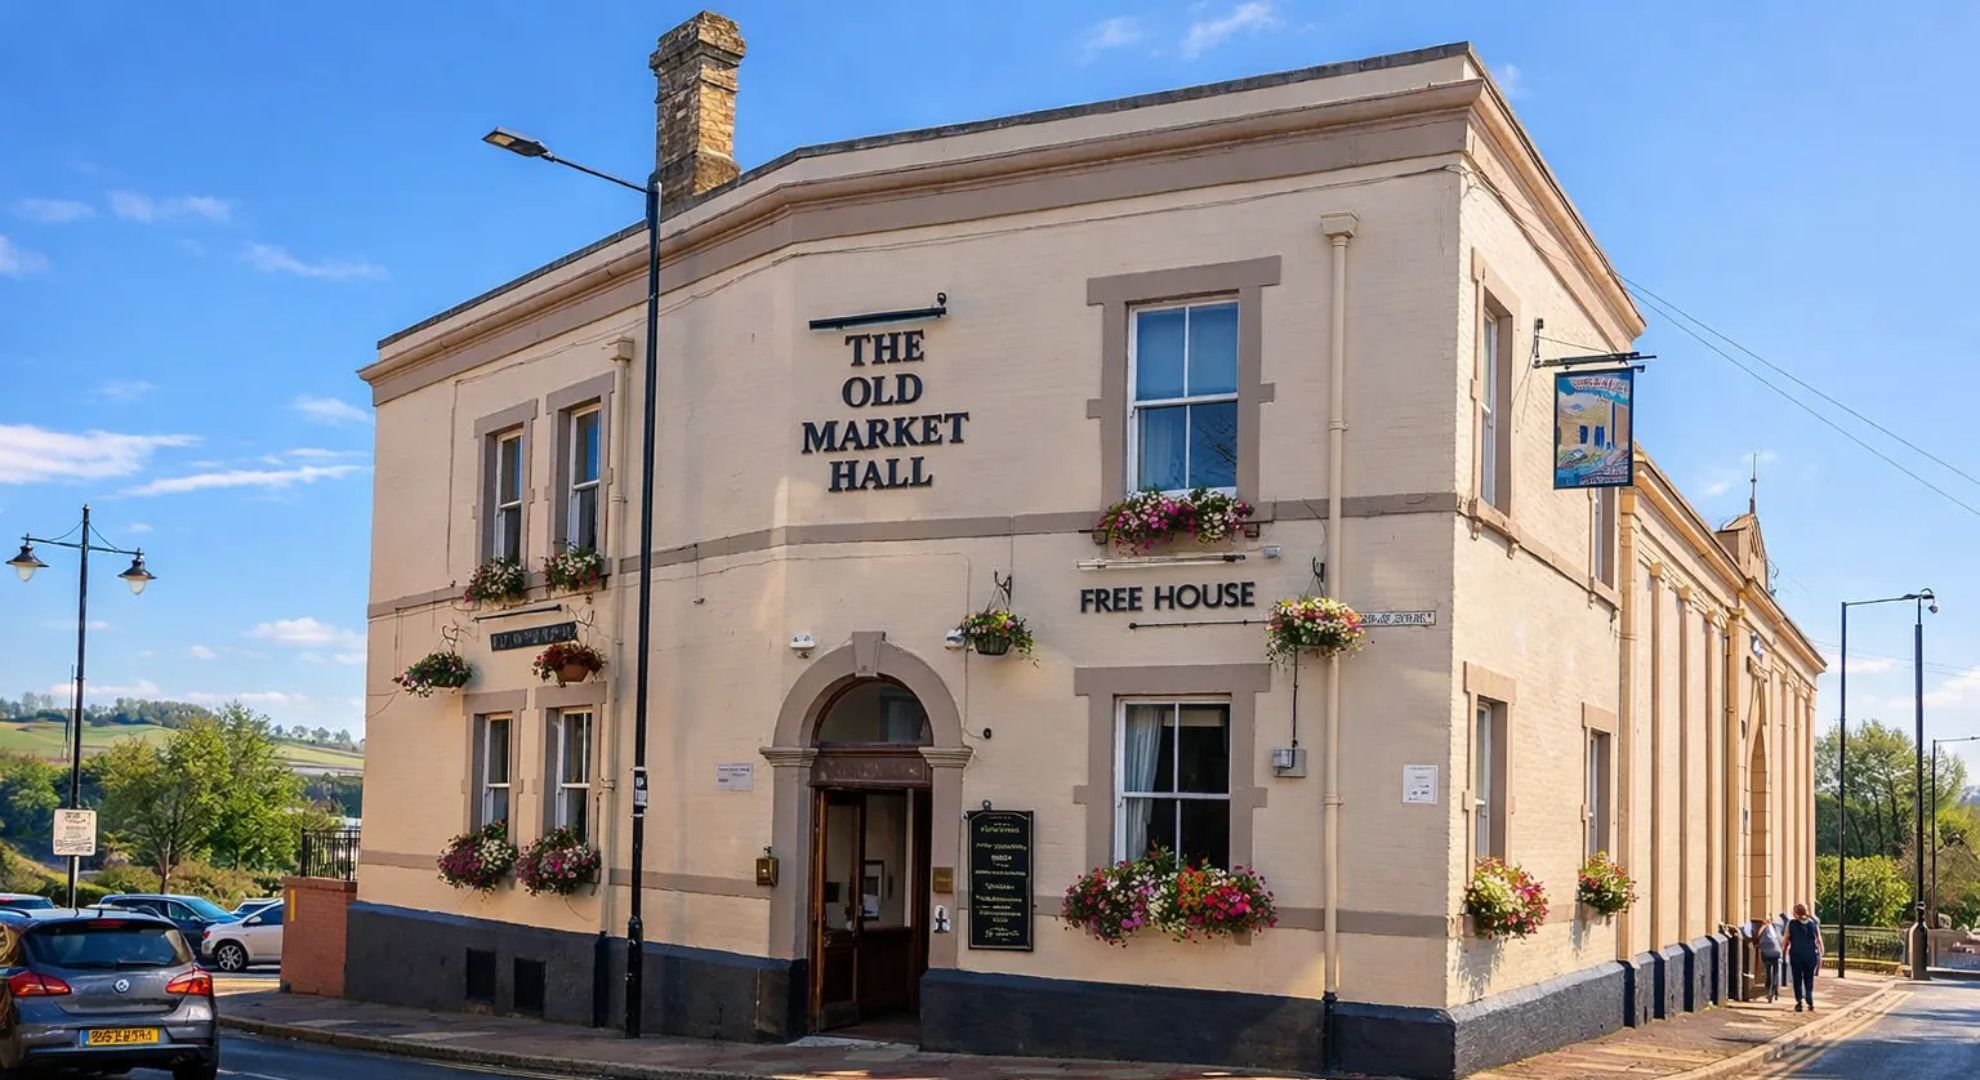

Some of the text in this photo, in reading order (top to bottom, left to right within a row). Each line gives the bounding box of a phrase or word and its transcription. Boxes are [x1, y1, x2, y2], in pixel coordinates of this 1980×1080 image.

[845, 329, 925, 367] THE
[842, 373, 923, 408] OLD
[802, 412, 970, 455] MARKET
[828, 456, 933, 493] HALL
[1080, 581, 1256, 614] FREE HOUSE
